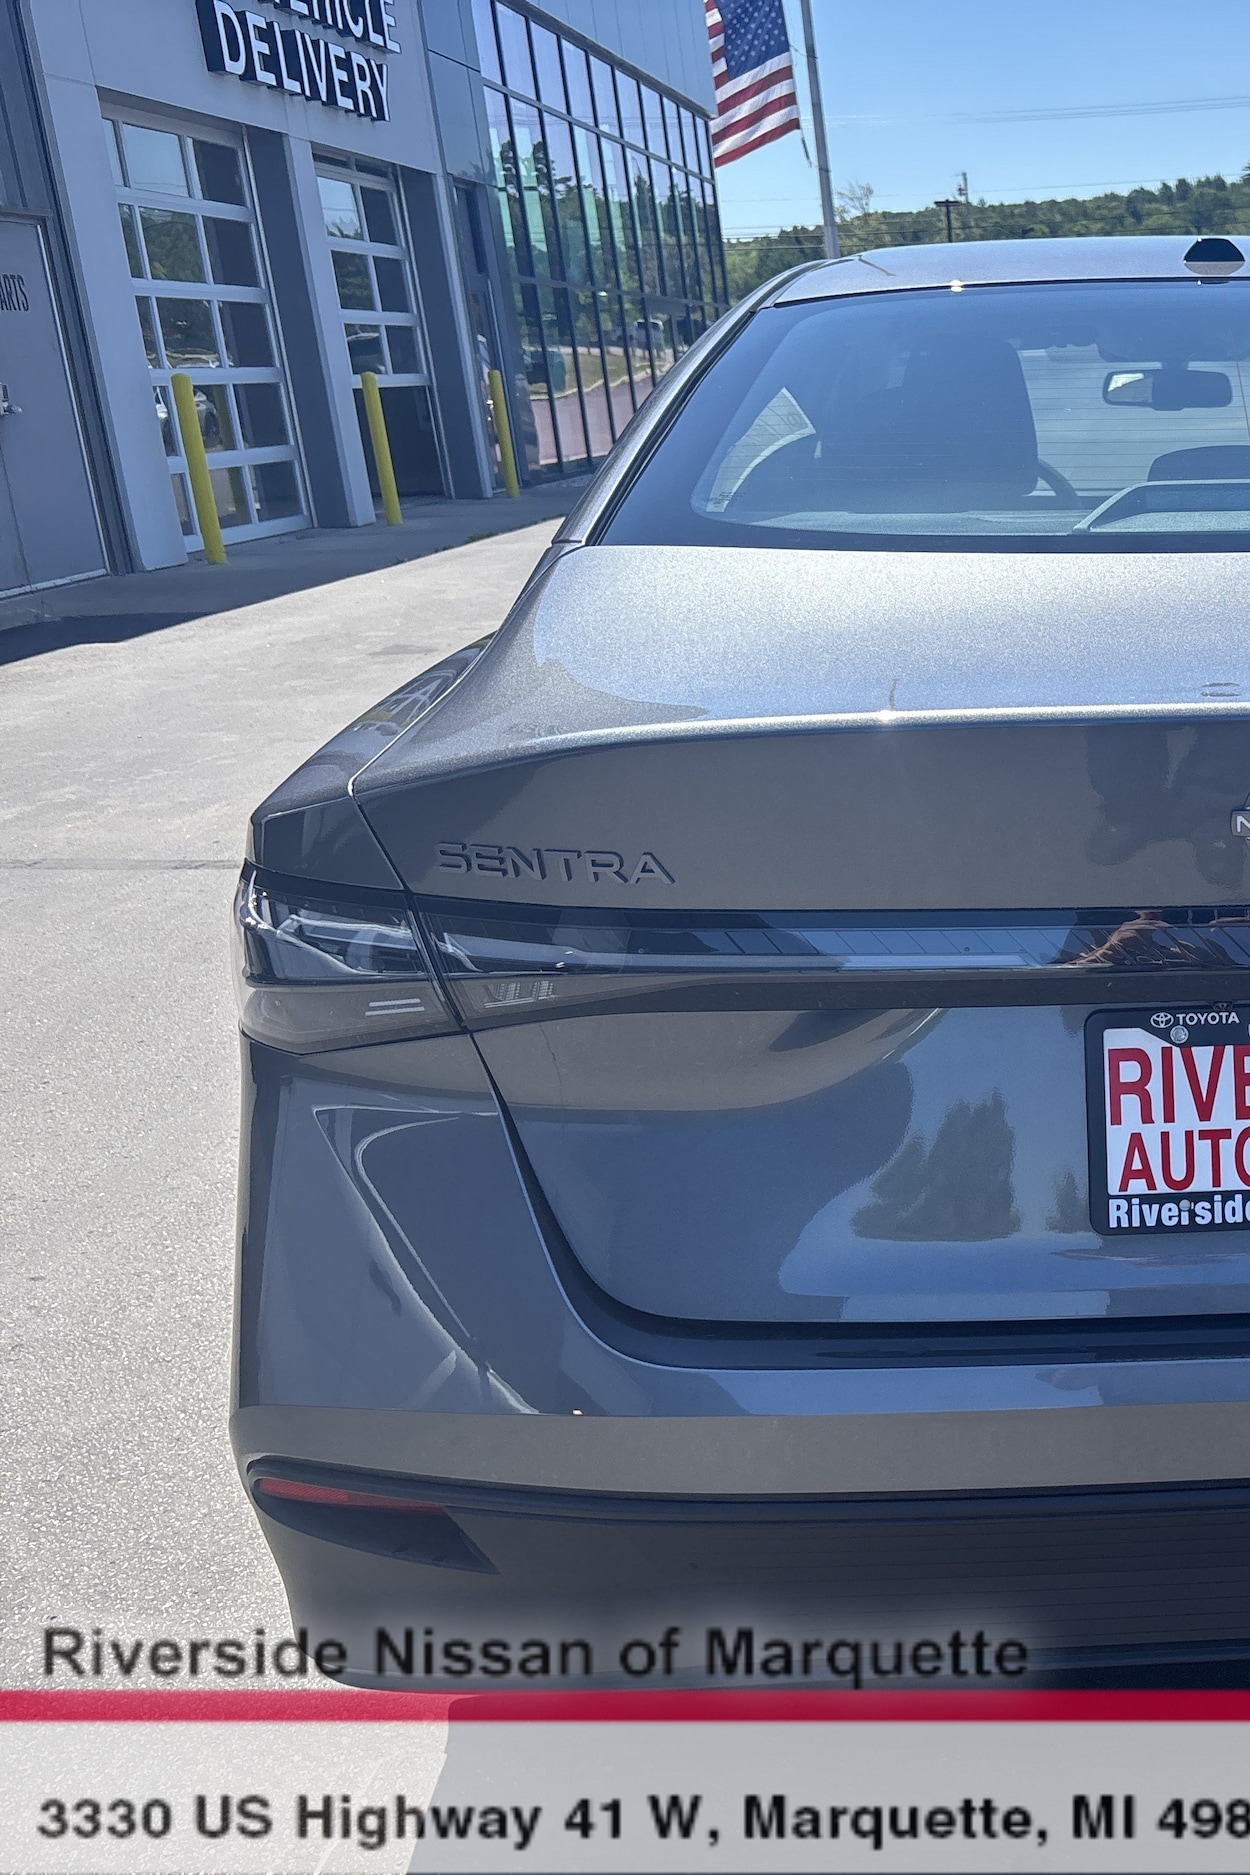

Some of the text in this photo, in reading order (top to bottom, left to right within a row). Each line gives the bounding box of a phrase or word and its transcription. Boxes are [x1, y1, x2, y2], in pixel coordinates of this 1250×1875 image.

[213, 0, 390, 122] DELIVERY
[434, 841, 676, 885] SENTRA
[1175, 1011, 1241, 1026] TOYOTA
